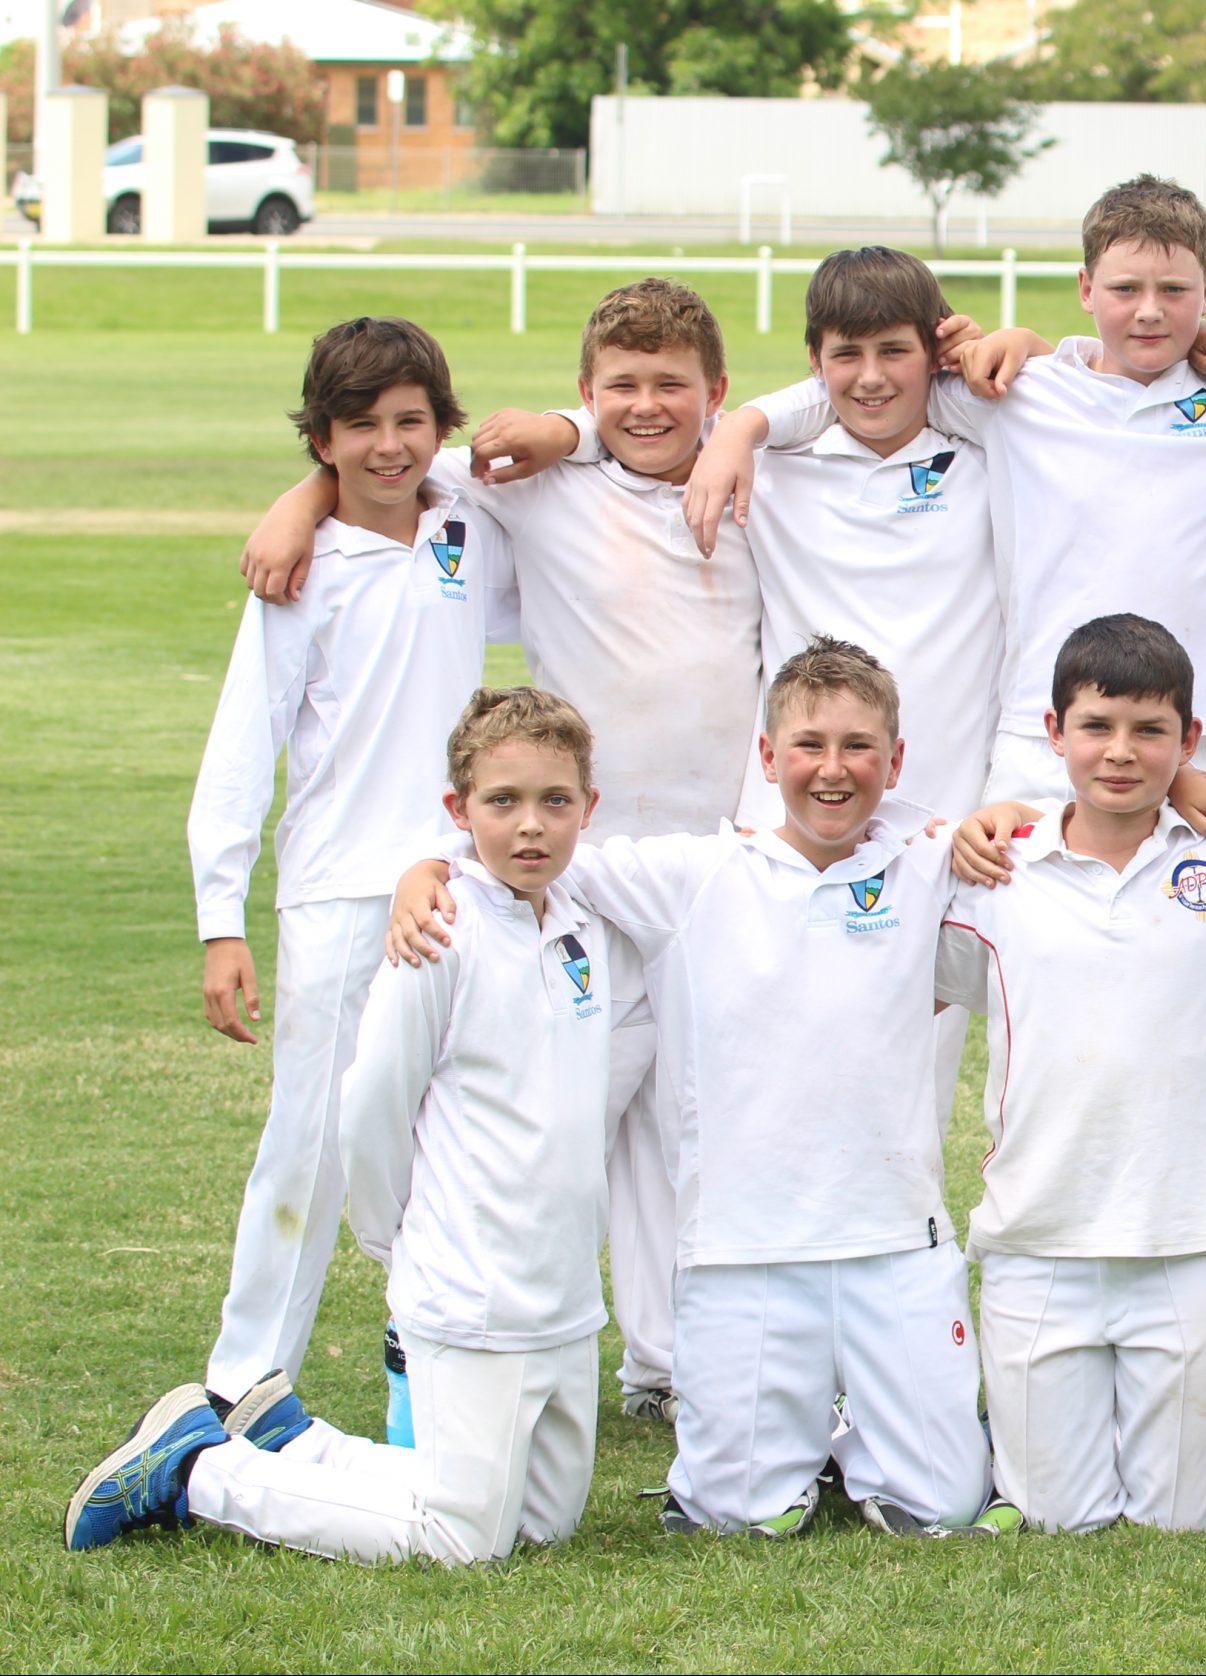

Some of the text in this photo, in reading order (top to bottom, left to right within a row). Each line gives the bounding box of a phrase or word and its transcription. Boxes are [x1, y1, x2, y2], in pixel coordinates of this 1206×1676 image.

[441, 589, 467, 602] Santos
[845, 918, 900, 934] Santos
[576, 1005, 602, 1020] Santos
